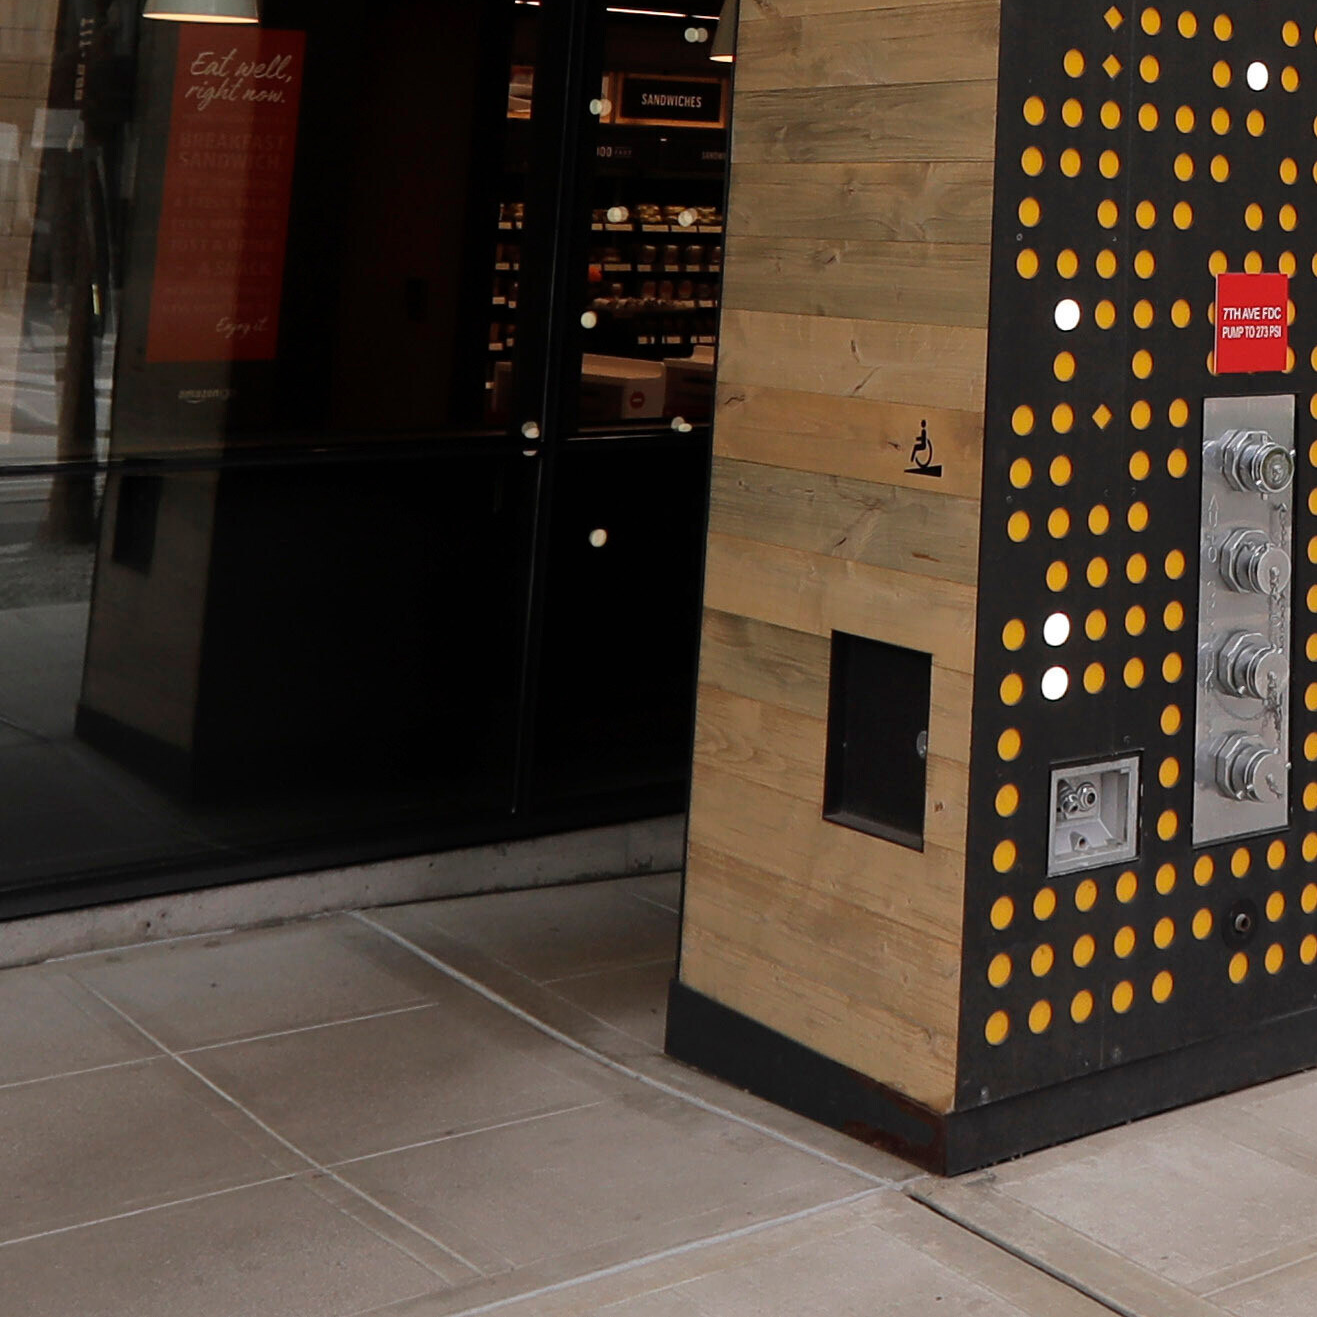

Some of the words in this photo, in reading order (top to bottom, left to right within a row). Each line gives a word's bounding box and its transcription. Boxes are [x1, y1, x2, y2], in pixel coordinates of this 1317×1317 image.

[190, 48, 238, 77] Eat
[235, 54, 293, 82] well,
[185, 78, 242, 111] right
[242, 87, 287, 104] now.
[641, 92, 702, 109] SANDWICHES
[1222, 307, 1241, 320] 7TH
[1242, 307, 1260, 320] AVE
[1262, 307, 1281, 320] FDC
[1222, 326, 1244, 339] PUMP
[1244, 326, 1255, 338] TO
[1256, 326, 1268, 338] 273
[1269, 325, 1281, 337] PSI
[178, 388, 219, 402] amazon
